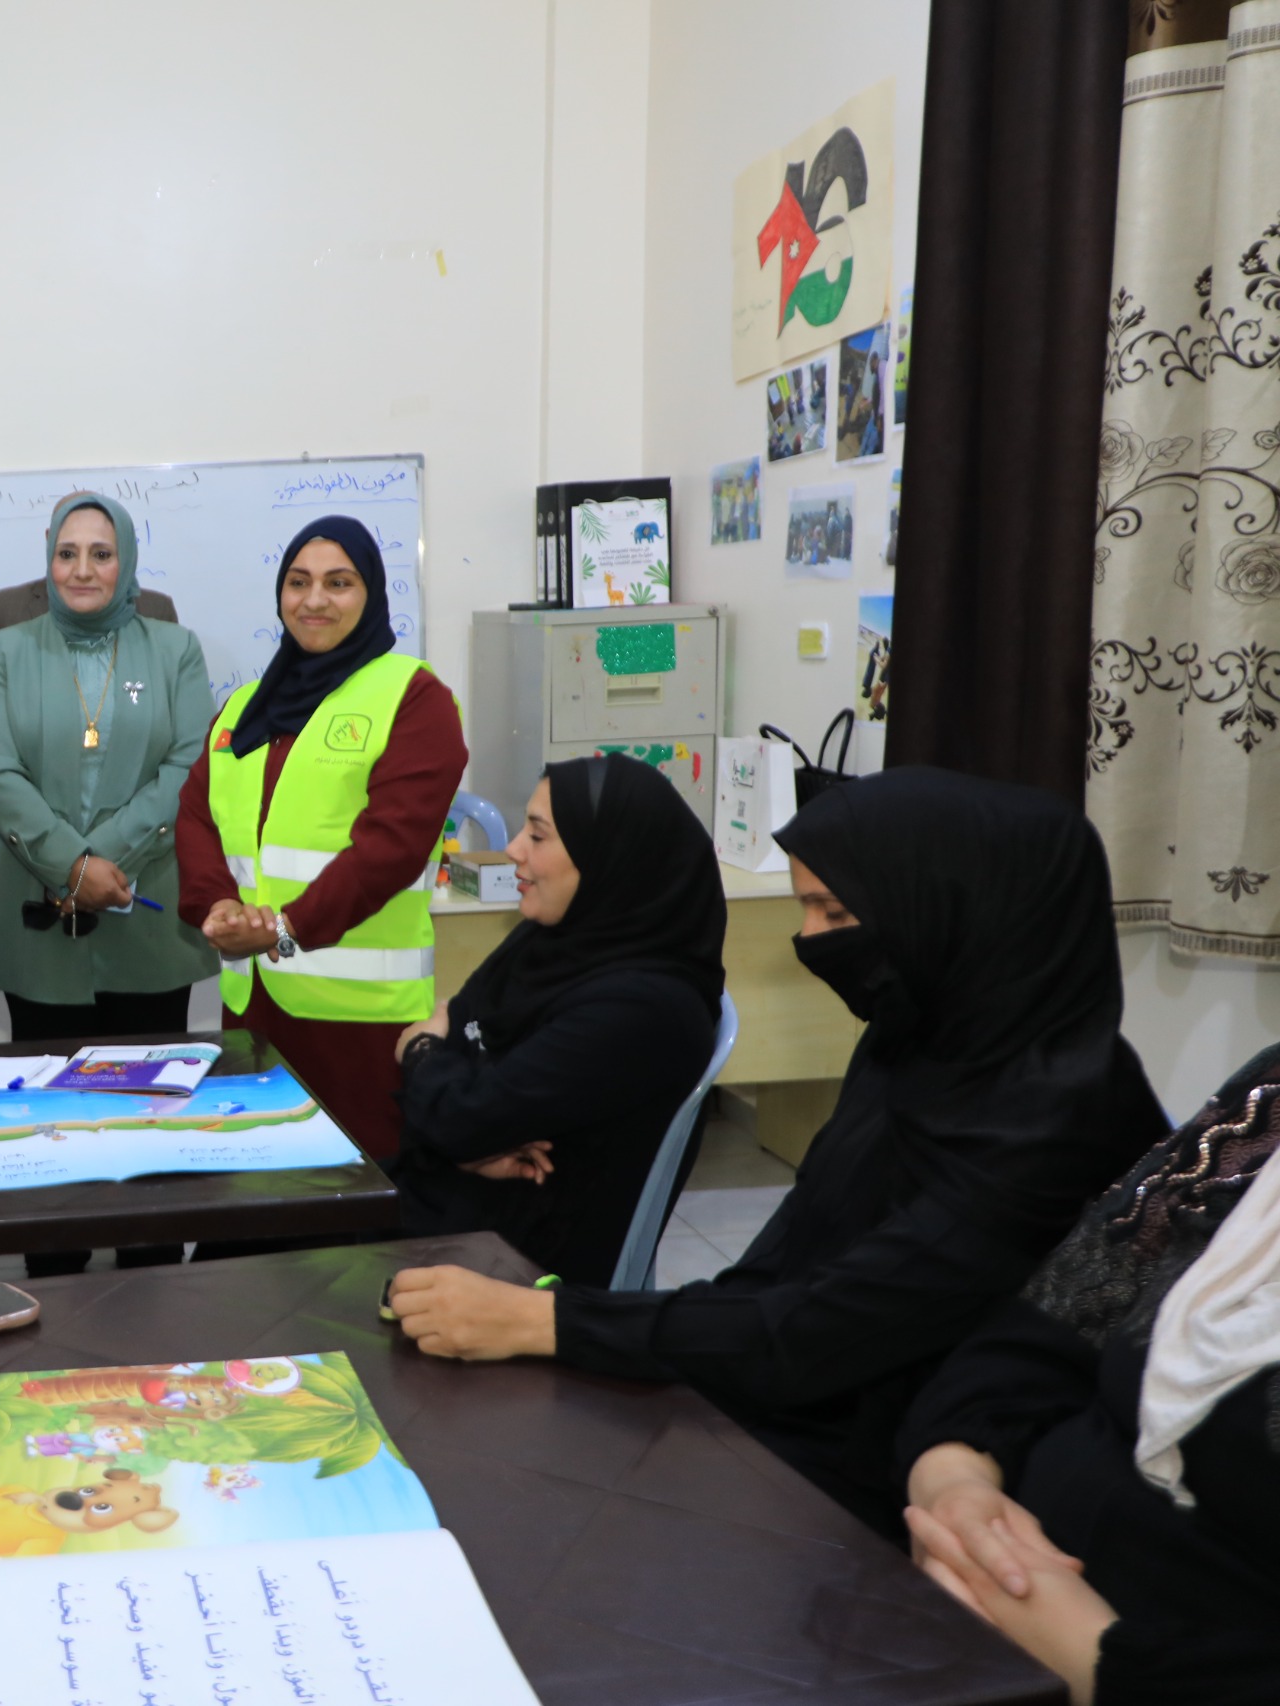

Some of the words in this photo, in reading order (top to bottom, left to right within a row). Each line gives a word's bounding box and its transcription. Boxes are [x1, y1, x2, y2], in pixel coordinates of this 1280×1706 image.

[314, 471, 359, 499] الطفولة
[361, 466, 406, 495] مكون
[334, 1611, 366, 1649] دودو
[57, 1634, 80, 1690] سوسو
